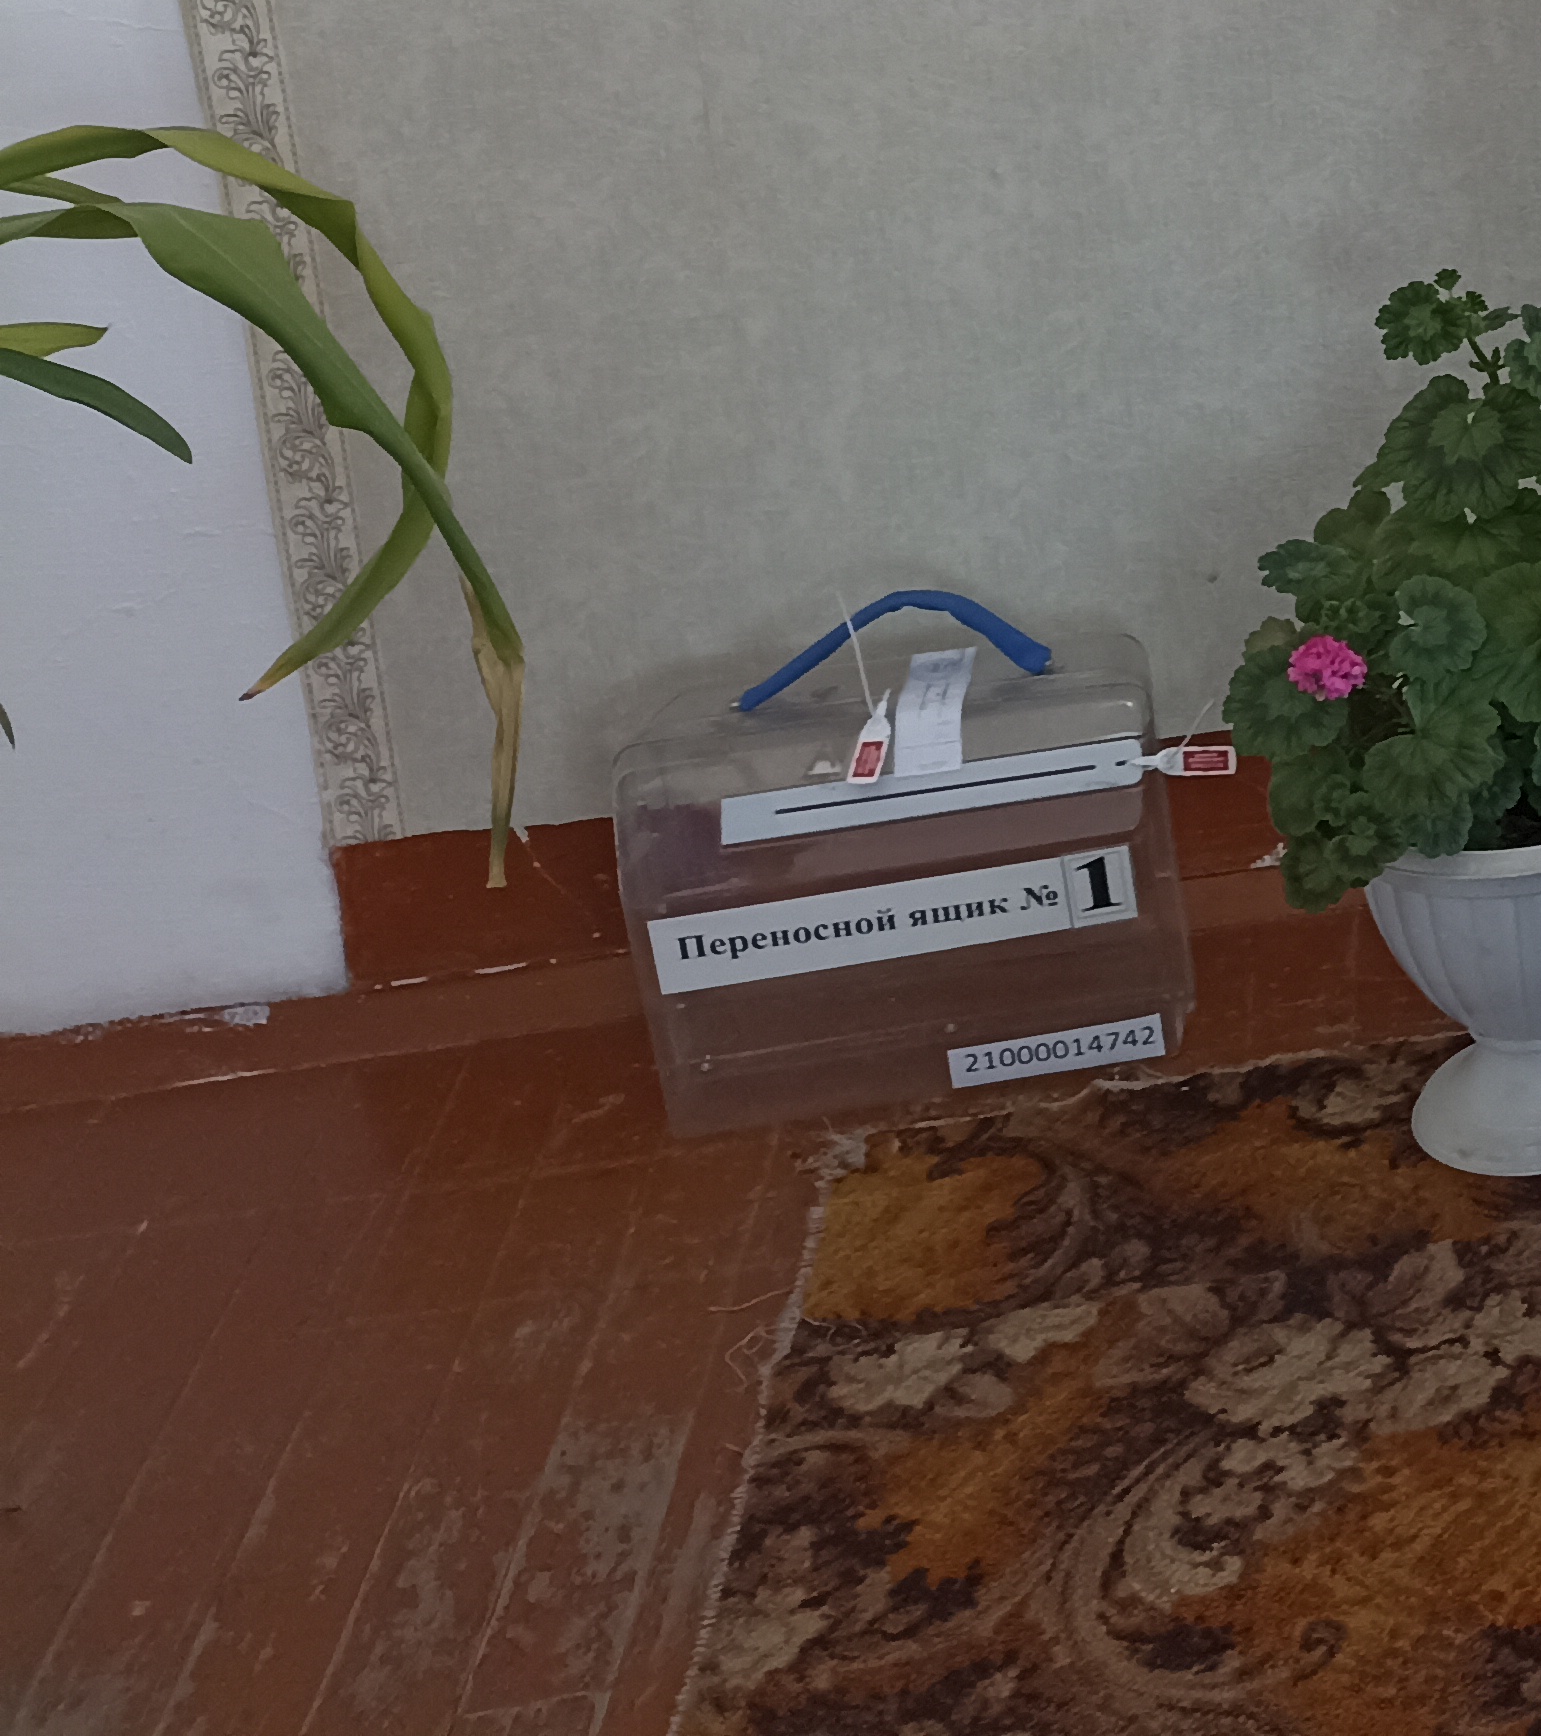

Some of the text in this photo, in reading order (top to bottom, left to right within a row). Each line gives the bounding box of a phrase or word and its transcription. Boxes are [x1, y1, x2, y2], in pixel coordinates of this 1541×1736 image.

[677, 907, 897, 961] Переносной
[908, 895, 1009, 929] ящик
[1073, 856, 1123, 913] 1
[964, 1025, 1157, 1073] 21000014742
